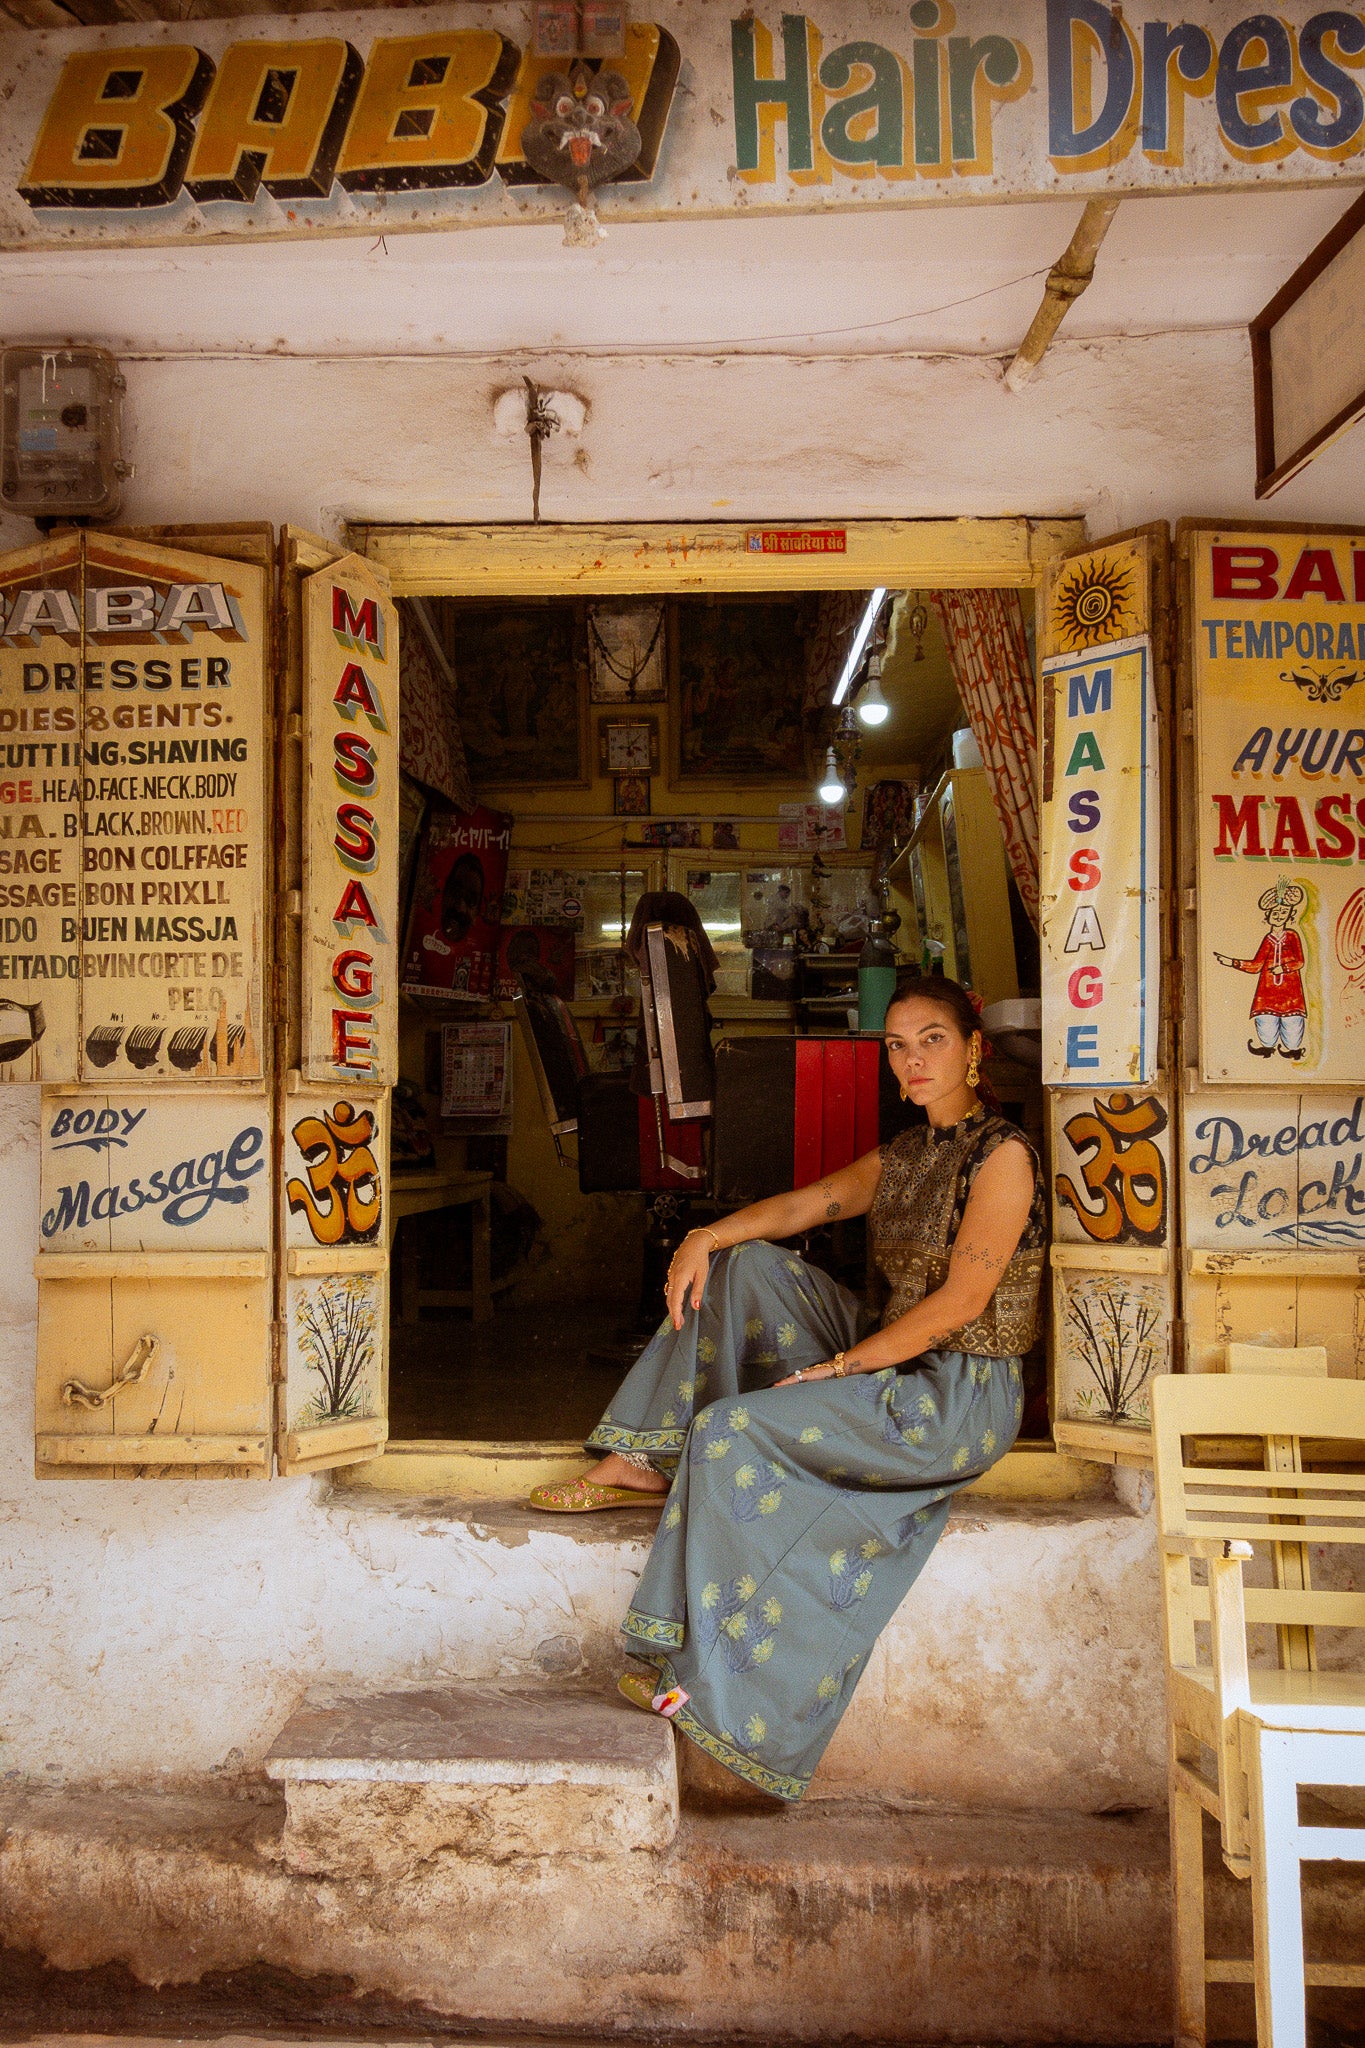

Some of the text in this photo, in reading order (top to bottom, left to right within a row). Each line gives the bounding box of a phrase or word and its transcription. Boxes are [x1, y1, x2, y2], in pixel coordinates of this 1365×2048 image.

[731, 0, 1032, 186] Hair
[1045, 0, 1365, 175] Dres
[763, 532, 779, 551] श्री
[826, 531, 845, 550] सेठ
[1211, 545, 1365, 604] BA
[0, 583, 248, 648] ABA
[23, 657, 231, 694] DRESSER
[1232, 727, 1365, 782] AYUR
[331, 584, 390, 1080] MASSAGE
[1211, 793, 1365, 864] MAS
[0, 849, 61, 873] SAGE
[84, 847, 136, 871] BON
[1063, 668, 1113, 1069] MASSAGE
[85, 882, 134, 905] BON
[141, 881, 230, 905] PRIXLL
[61, 917, 127, 943] BUEN
[135, 917, 238, 942] MASSJA
[211, 952, 243, 978] DE
[168, 987, 223, 1011] PELO
[50, 1108, 147, 1138] BODY
[1189, 1096, 1365, 1174] Dread
[42, 1126, 265, 1237] Massage
